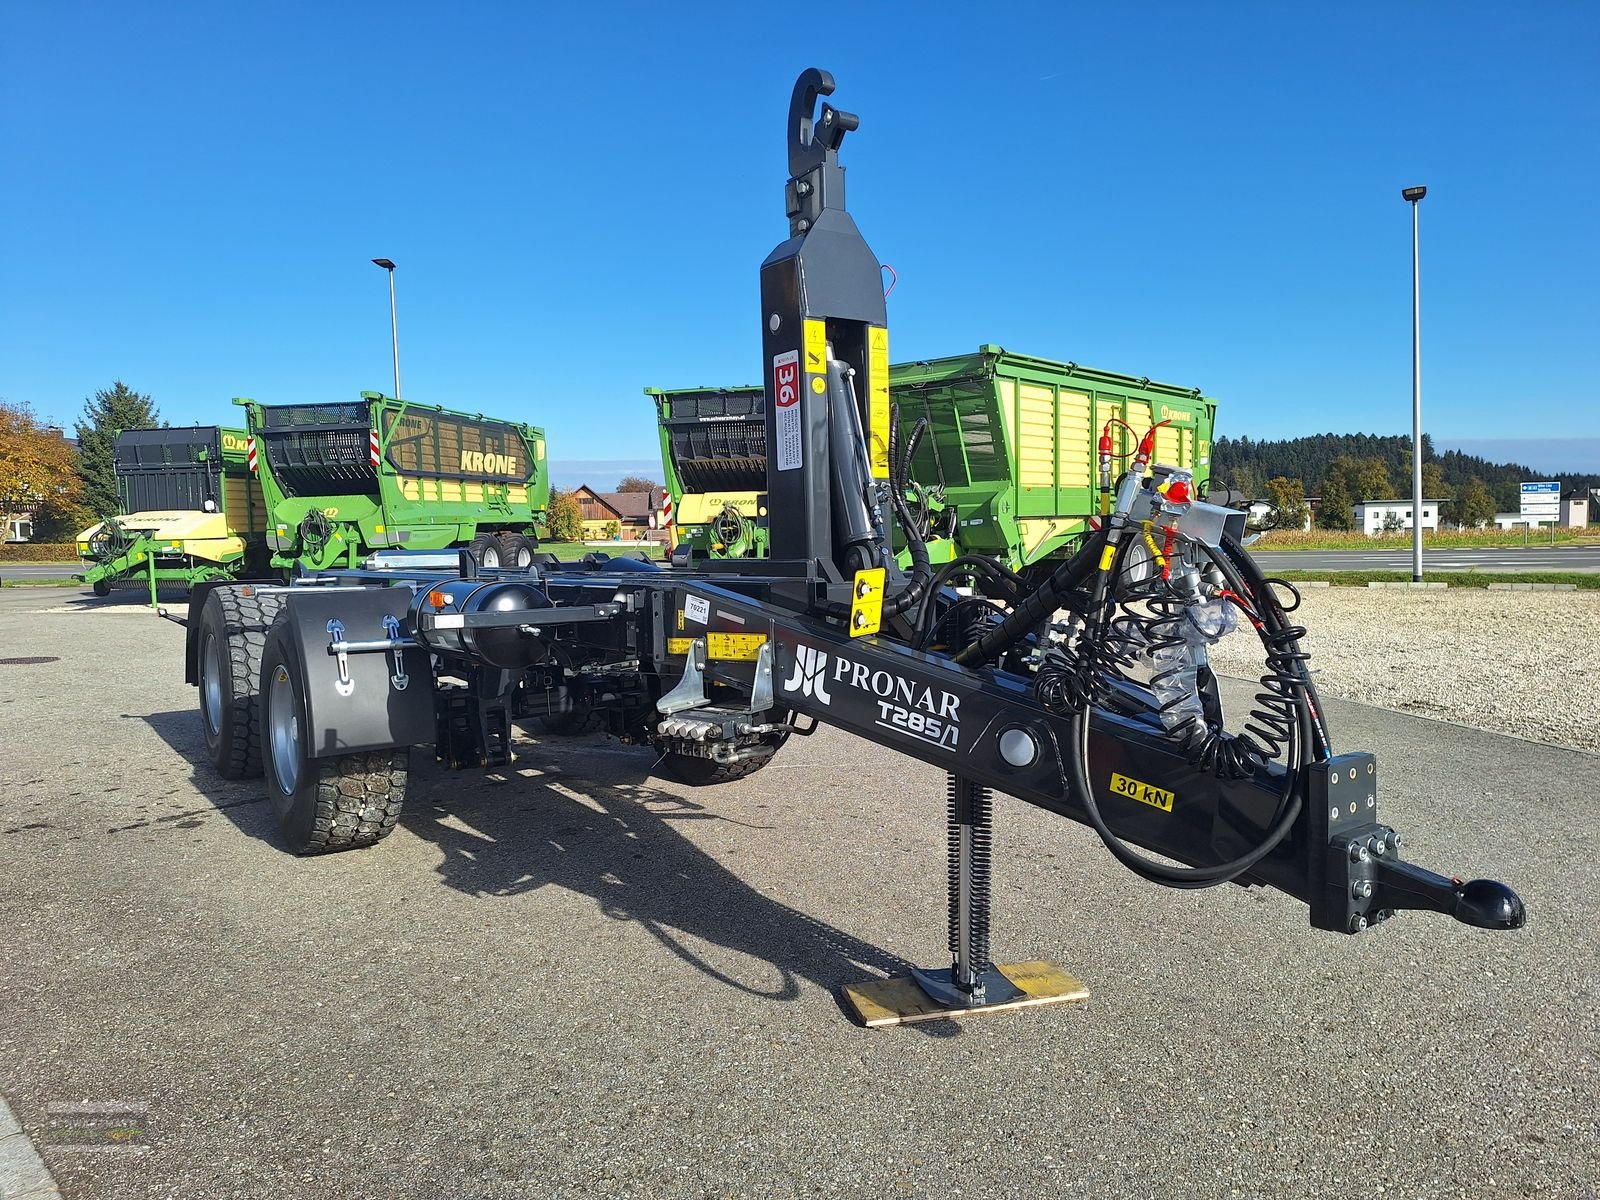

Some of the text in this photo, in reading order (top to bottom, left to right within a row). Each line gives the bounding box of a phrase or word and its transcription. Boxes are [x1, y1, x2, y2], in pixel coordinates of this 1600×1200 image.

[778, 367, 795, 404] 36
[397, 418, 422, 429] RONE
[1168, 409, 1191, 421] KRONE
[460, 450, 517, 476] KRONE
[690, 603, 707, 614] 70221
[832, 655, 962, 723] PRONAR
[876, 699, 961, 746] T285/1
[1115, 777, 1169, 809] 30 kN
